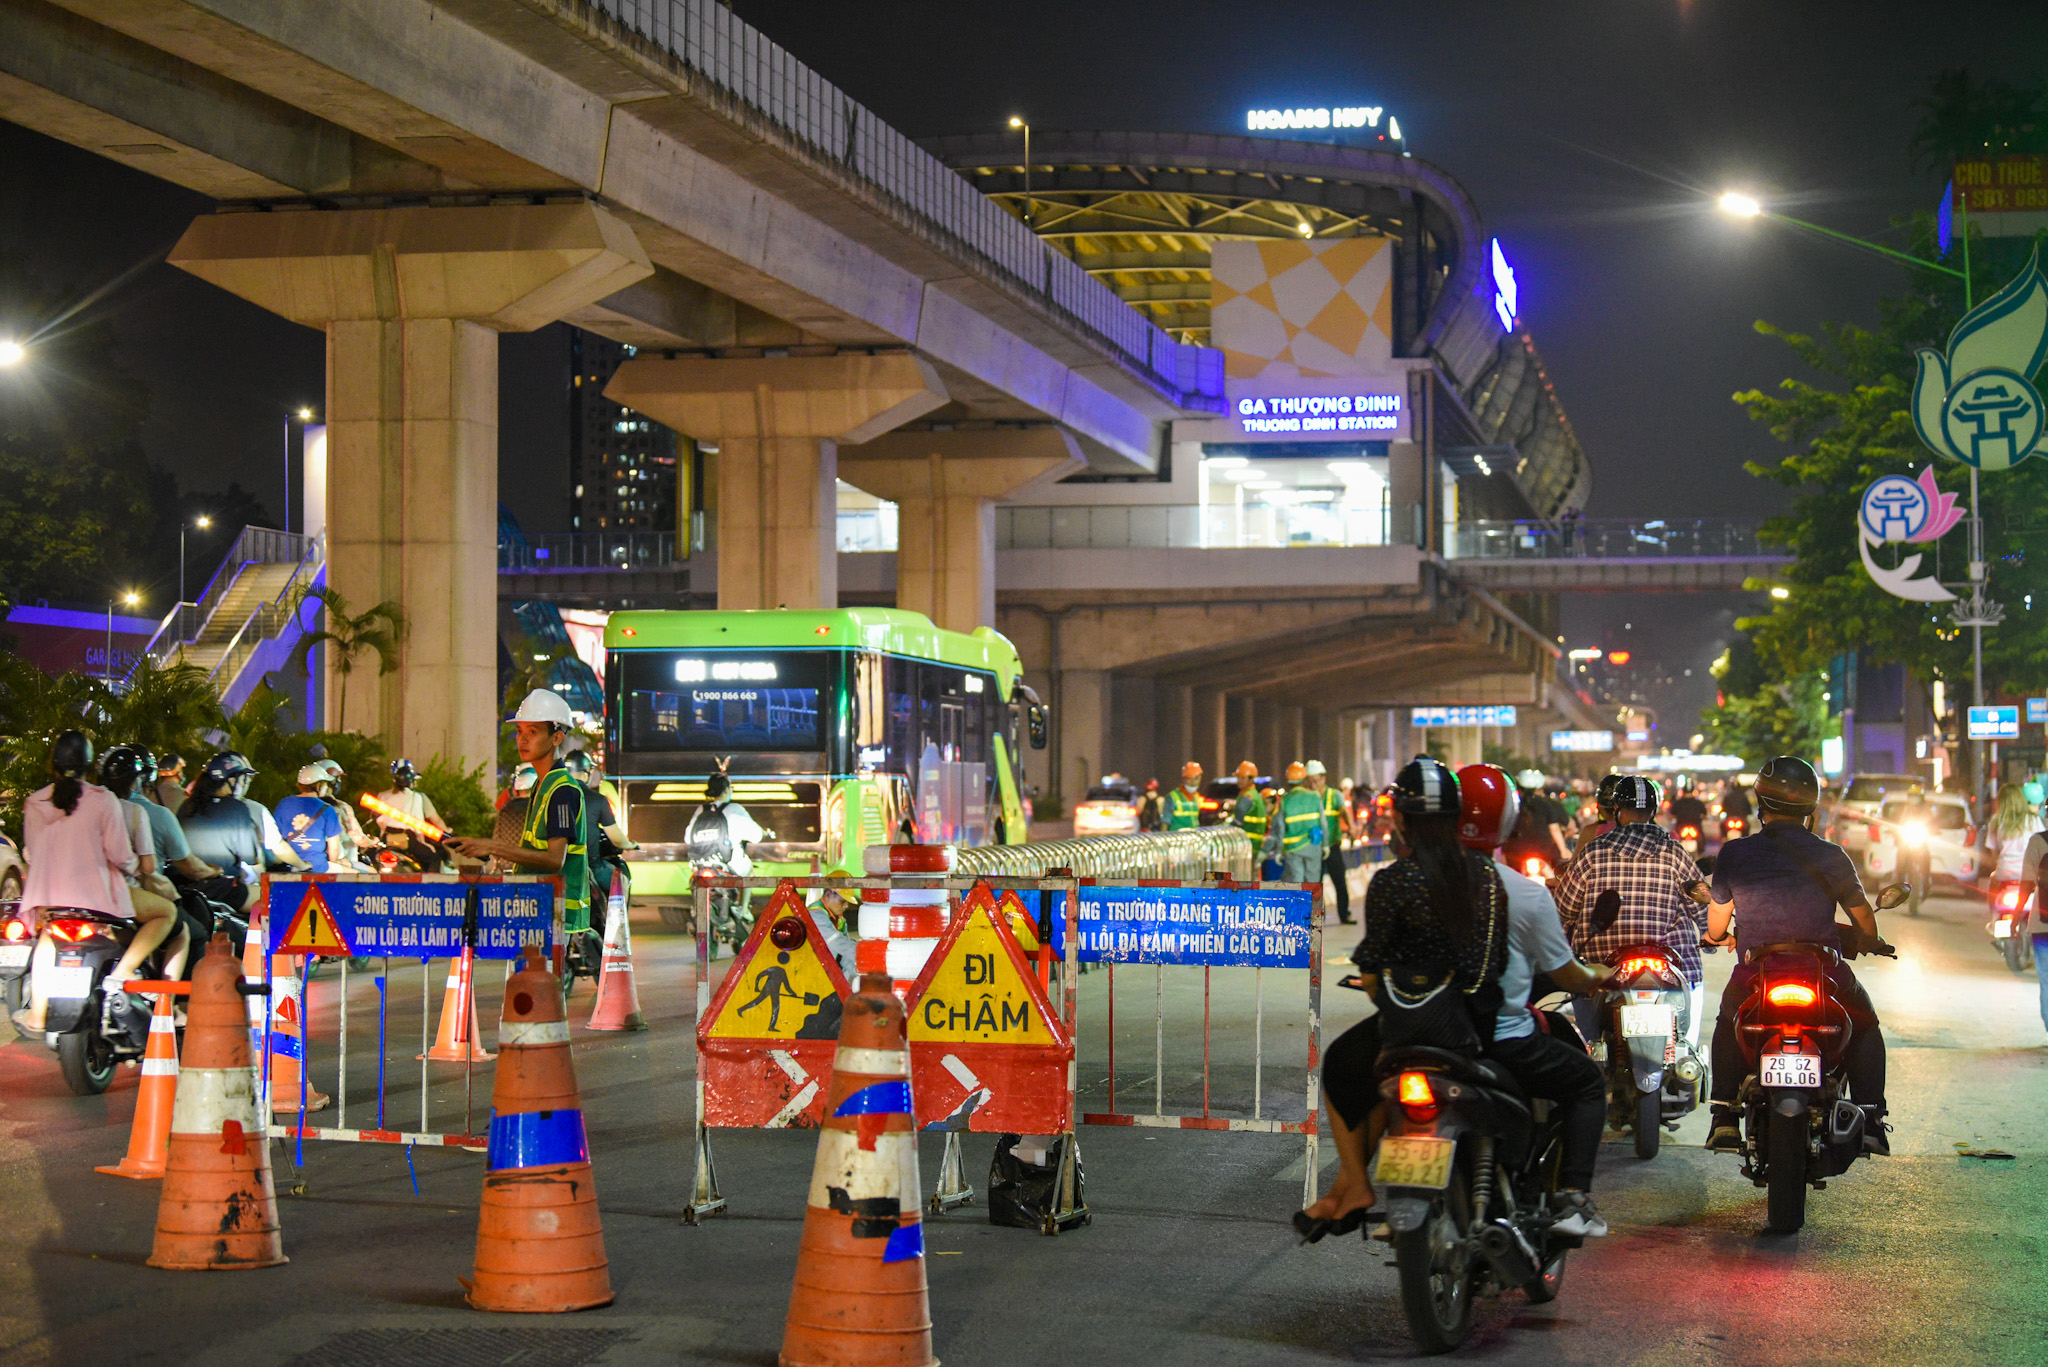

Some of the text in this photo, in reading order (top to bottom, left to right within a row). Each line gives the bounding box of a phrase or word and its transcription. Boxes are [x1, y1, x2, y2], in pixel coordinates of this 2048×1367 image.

[1248, 107, 1382, 129] HOANG HUY
[1954, 162, 1992, 186] CHO
[1239, 392, 1400, 416] GA THƯỢNG ĐÌNH
[1243, 416, 1397, 432] THUONG DINH STATION
[699, 692, 758, 700] 1900 866 663
[392, 891, 441, 916] TRƯỜNG
[444, 897, 478, 917] ĐAN
[504, 894, 538, 917] CÔNG
[1060, 897, 1286, 925] CNG TRƯỜNG ĐANG THI CÔNG
[355, 926, 376, 946] XIN
[380, 919, 398, 946] LỖI
[400, 923, 418, 946] ĐÃ
[422, 923, 448, 946] LÀM
[491, 924, 516, 948] CÁC
[1091, 924, 1114, 951] LỖI
[1118, 928, 1139, 952] ĐÃ
[1180, 926, 1225, 954] PHIỀN
[1230, 931, 1260, 954] CÁC
[1264, 936, 1296, 959] BẠN
[963, 953, 994, 985] ĐI
[925, 993, 1029, 1038] CHẬM
[1770, 1058, 1786, 1070] 29
[1765, 1071, 1816, 1085] 016.06
